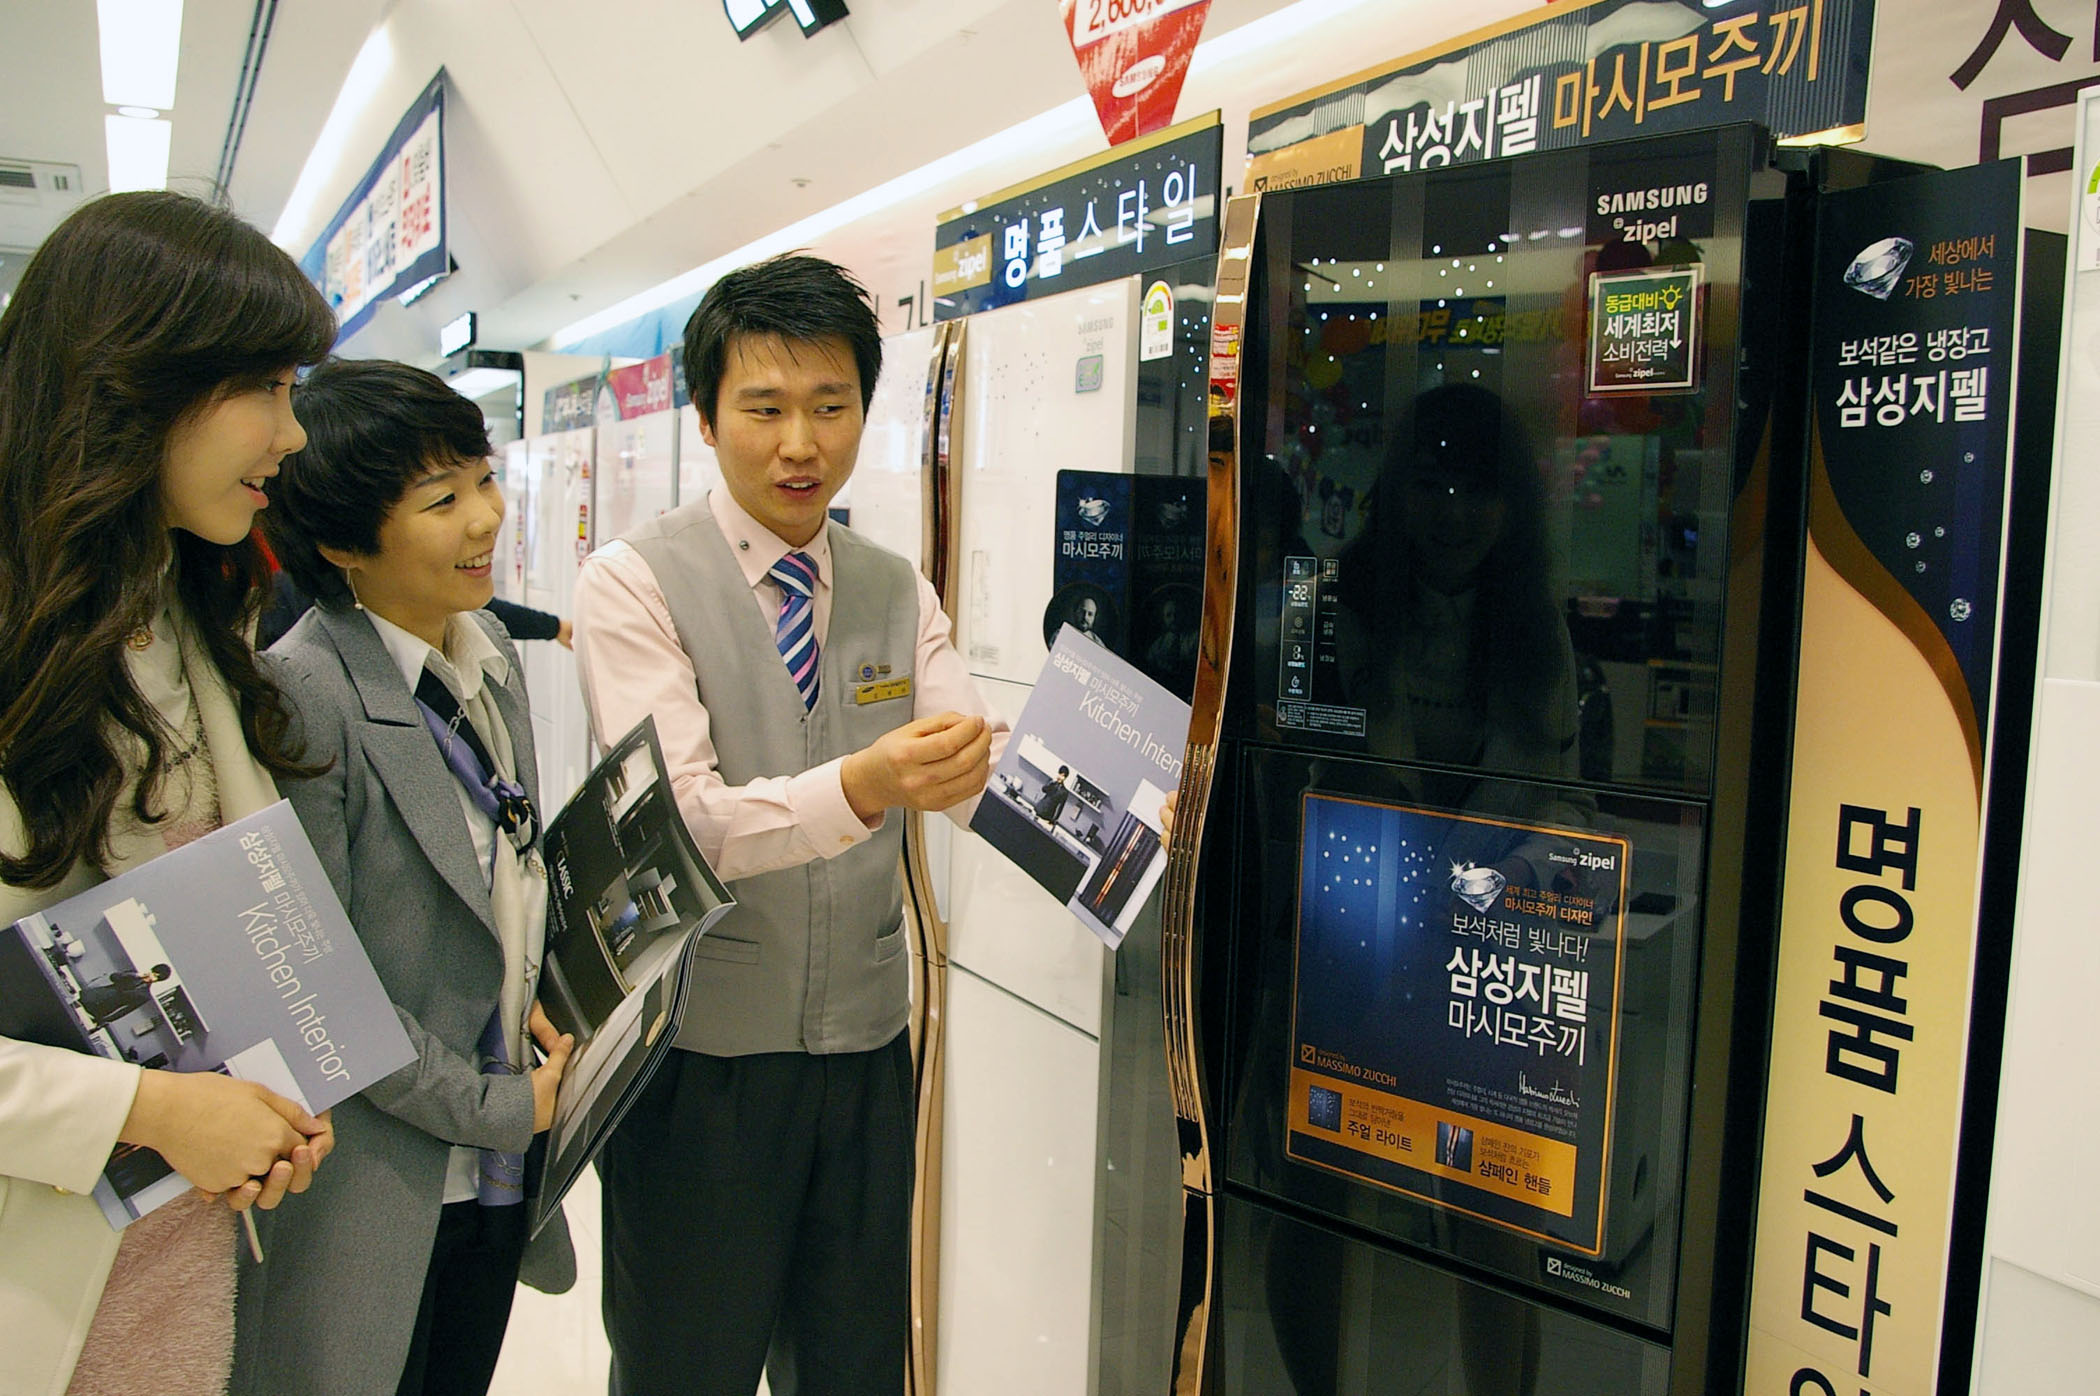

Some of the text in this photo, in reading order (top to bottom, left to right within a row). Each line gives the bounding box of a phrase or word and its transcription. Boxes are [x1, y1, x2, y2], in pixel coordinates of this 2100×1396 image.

[1119, 66, 1159, 87] SAMSUNG
[1378, 0, 1823, 175] 삼성지펠 마시모주끼
[1597, 182, 1708, 215] SAMSUNG
[1623, 215, 1677, 245] zipel
[1928, 235, 1995, 267] 세상에서
[1905, 270, 1994, 300] 가장 빛나는
[1605, 292, 1659, 313] 동급대비
[1604, 310, 1679, 340] 세계최저
[1602, 339, 1669, 363] 소비전력
[1838, 327, 1990, 367] 보석같은 냉장고
[1633, 368, 1653, 379] zipel
[1836, 367, 1987, 428] 삼성지펠
[1062, 541, 1123, 560] 마시모주끼
[1090, 676, 1139, 717] 마시모주끼
[1079, 691, 1141, 749] Kitchen
[1548, 852, 1615, 871] Samsung zipel
[240, 832, 287, 893] 삼성지펠
[274, 891, 323, 964] 마시모주끼
[1504, 897, 1593, 926] 마시모주끼 디자인
[1451, 913, 1589, 963] 보석처럼 빛나다!
[238, 901, 352, 1085] Kitchen Interior
[1446, 946, 1589, 1024] 삼성지펠
[1447, 999, 1586, 1066] 마시모주끼
[1317, 1056, 1397, 1088] MASSIMO ZUCCHI
[1347, 1120, 1413, 1152] 주얼 라이트
[1479, 1160, 1552, 1196] 샴페인 핸들
[1562, 1270, 1631, 1299] MASSIMO ZUCCHI
